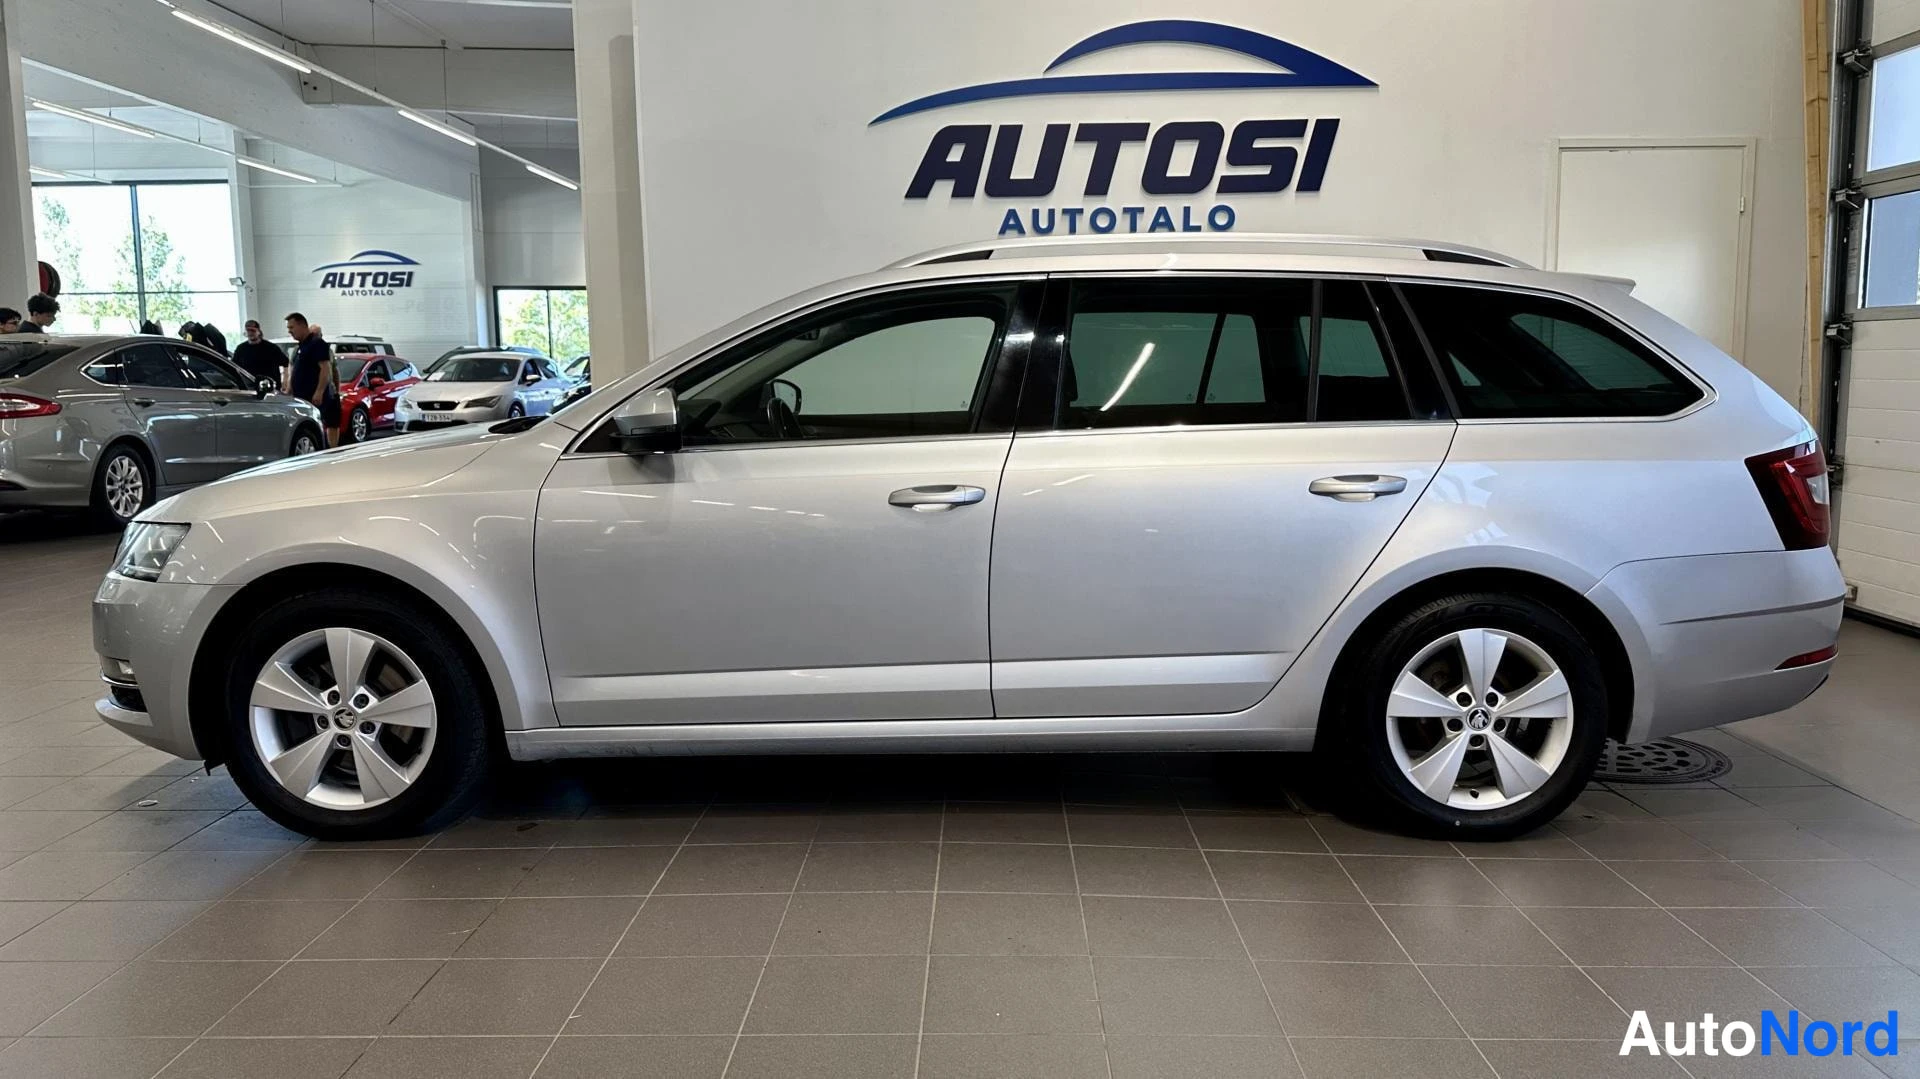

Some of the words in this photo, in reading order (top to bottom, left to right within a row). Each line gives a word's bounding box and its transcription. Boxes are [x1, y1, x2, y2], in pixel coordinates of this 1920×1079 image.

[904, 118, 1341, 199] AUTOSI
[998, 204, 1236, 235] AUTOTALO
[320, 271, 414, 288] AUTOSI
[341, 289, 395, 297] AUTOTALO
